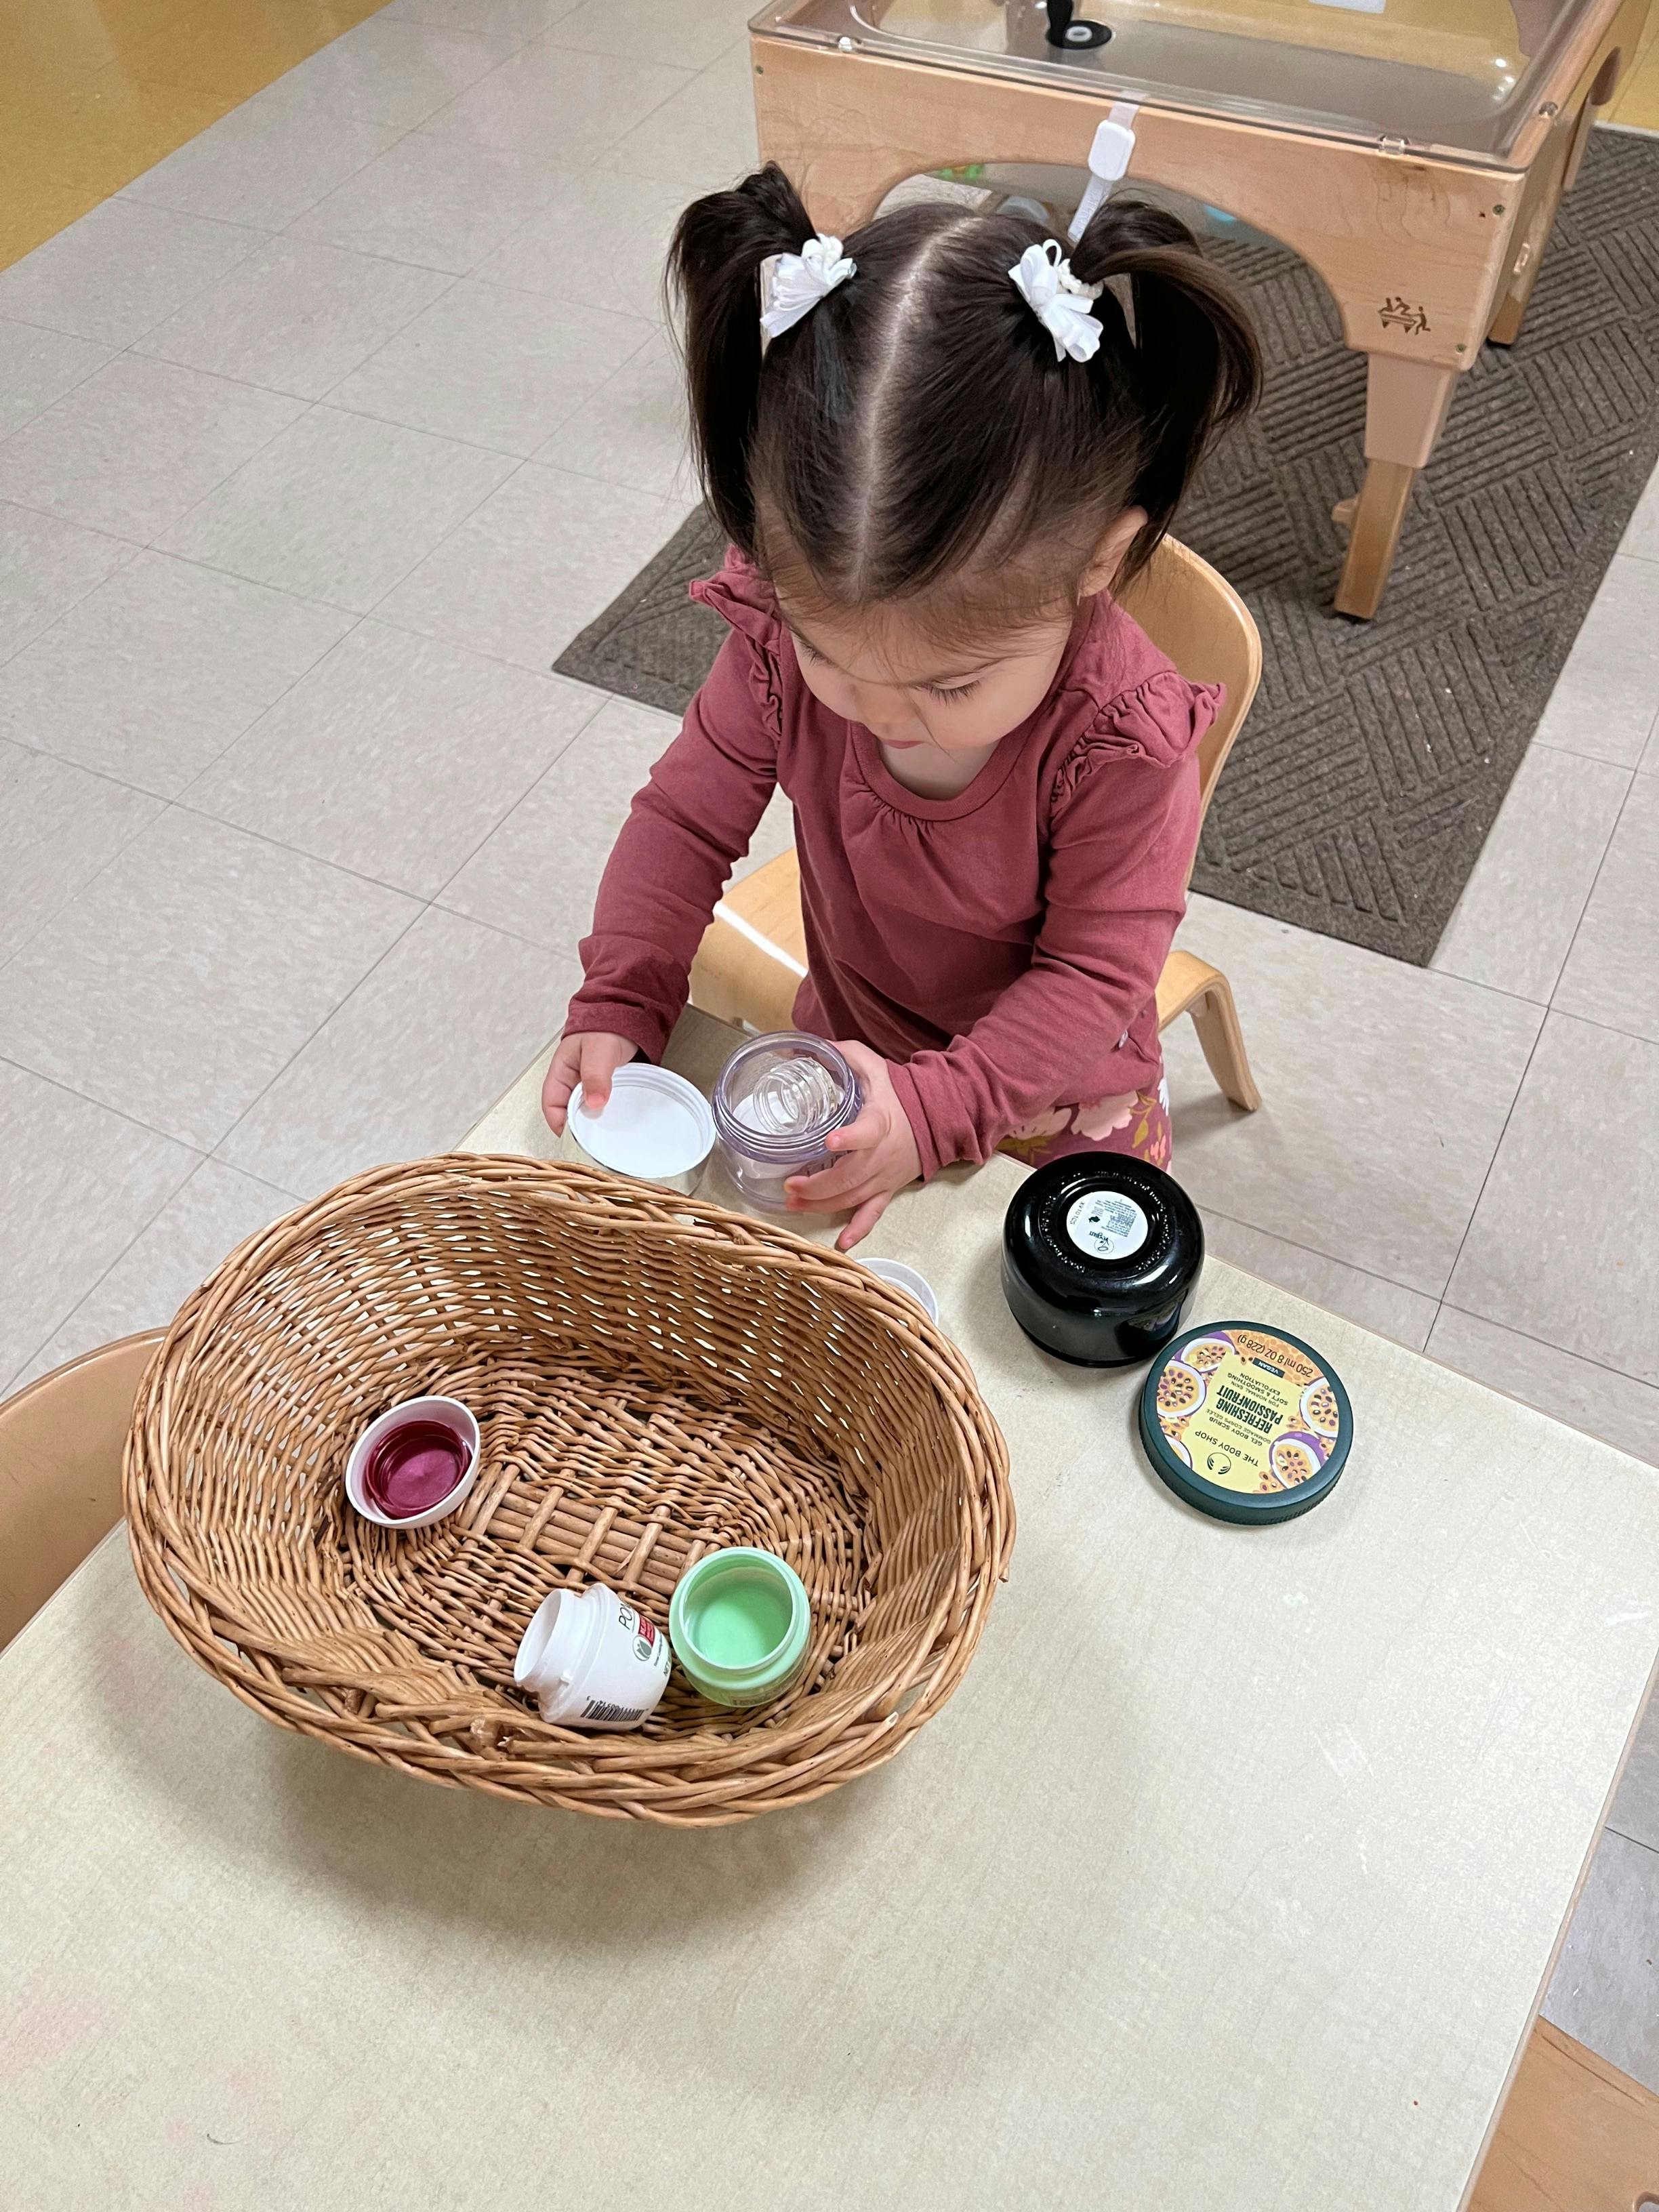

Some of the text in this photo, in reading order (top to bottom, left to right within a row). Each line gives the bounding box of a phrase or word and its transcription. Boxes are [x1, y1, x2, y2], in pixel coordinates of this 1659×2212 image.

[1236, 1332, 1313, 1378] 250 ml 8 OZ (228 g)
[1258, 1361, 1279, 1374] VEGAN
[1227, 1372, 1265, 1394] SMOOTHING
[1231, 1380, 1279, 1408] FOR NORMAL SKIN
[1240, 1372, 1281, 1396] EXFOLIATION
[1216, 1385, 1284, 1425] PASSIONFRUIT
[1271, 1395, 1288, 1406] SOFT
[1216, 1397, 1273, 1434] REFRESHING
[1224, 1418, 1242, 1430] CORPS
[1208, 1416, 1263, 1446] GEL BODY SCRUB
[1243, 1427, 1271, 1445] GOMMAGE
[1194, 1429, 1260, 1467] THE BODY SHOP
